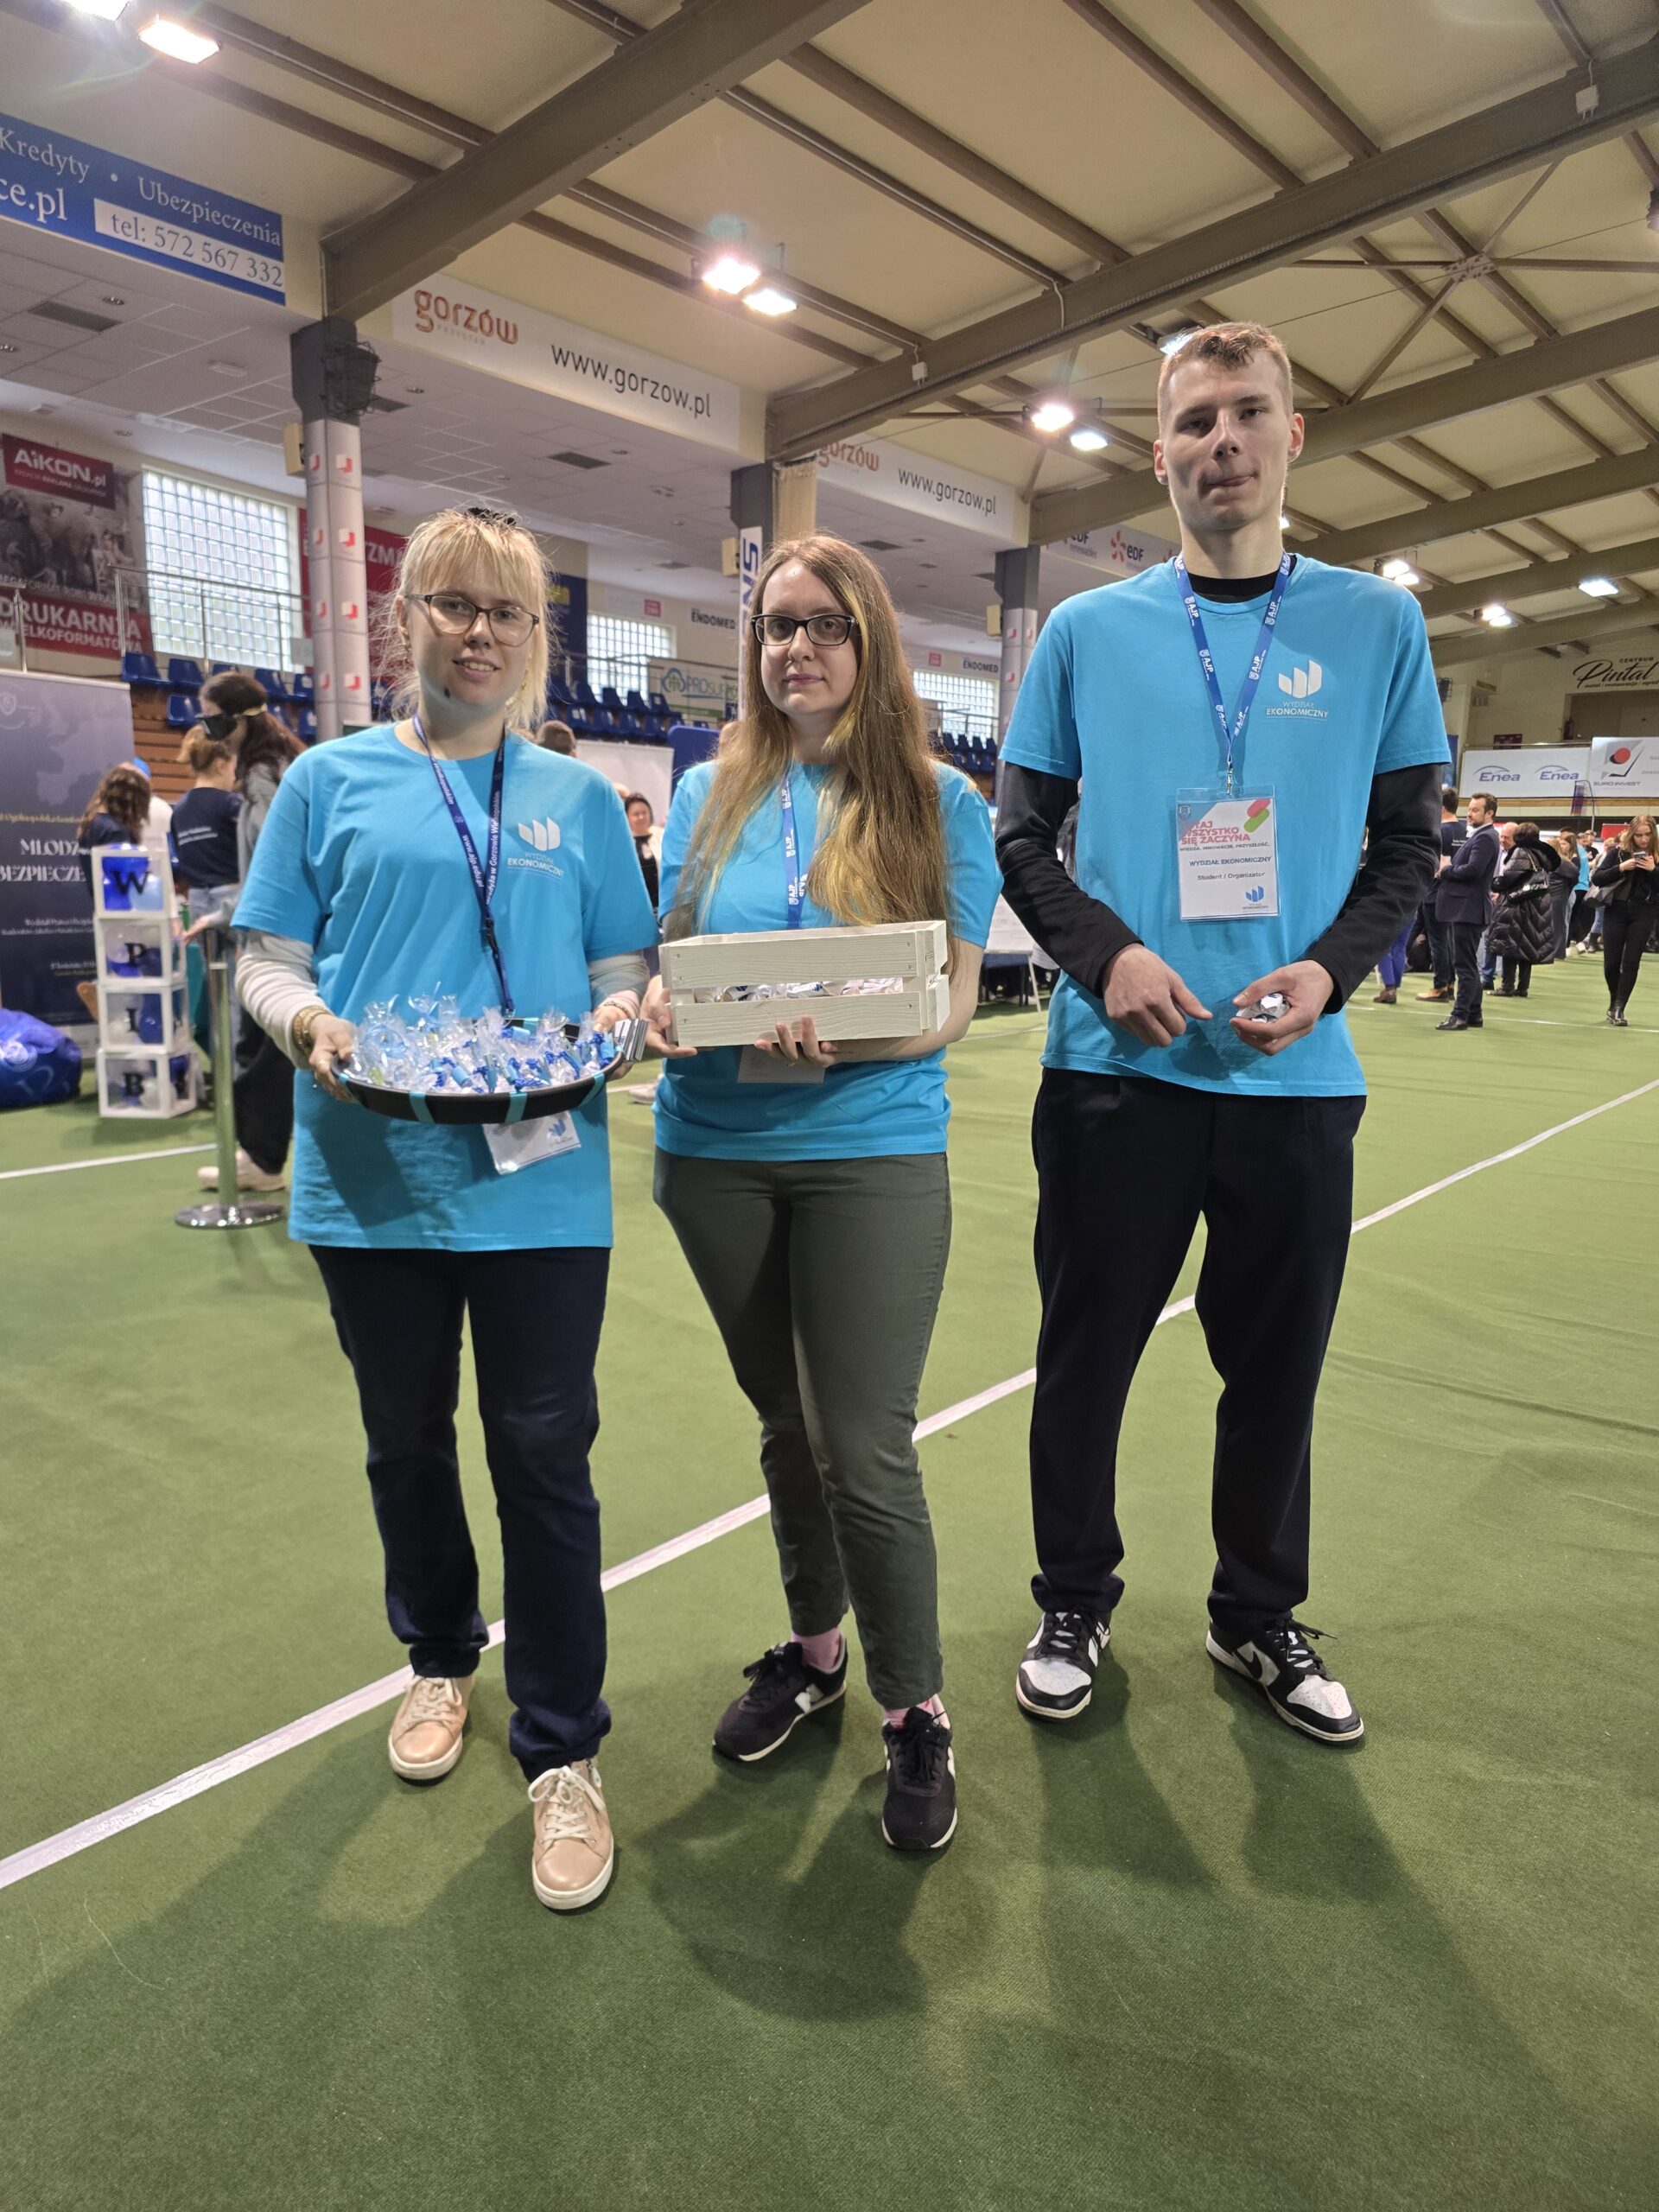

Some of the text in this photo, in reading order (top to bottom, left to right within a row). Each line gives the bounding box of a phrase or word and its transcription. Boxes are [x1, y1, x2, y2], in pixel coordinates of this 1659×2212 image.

[0, 127, 281, 247] Kredyty Ubezpieczenia
[111, 213, 283, 288] tel: 572 567 332
[415, 289, 518, 345] gorzów
[551, 345, 711, 419] www.gorzow.pl
[898, 467, 996, 517] www.gorzow.pl
[1266, 708, 1329, 718] EKONOMICZNY
[1478, 772, 1521, 782] Enea
[1539, 771, 1580, 781] Enea
[489, 835, 499, 866] Gorzowie
[1181, 833, 1250, 846] SIĘ ZACZYNA
[1221, 856, 1272, 865] EKONOMICZNY
[111, 870, 151, 894] W
[1228, 872, 1265, 880] Organizator
[124, 942, 148, 966] P
[123, 1071, 145, 1096] B
